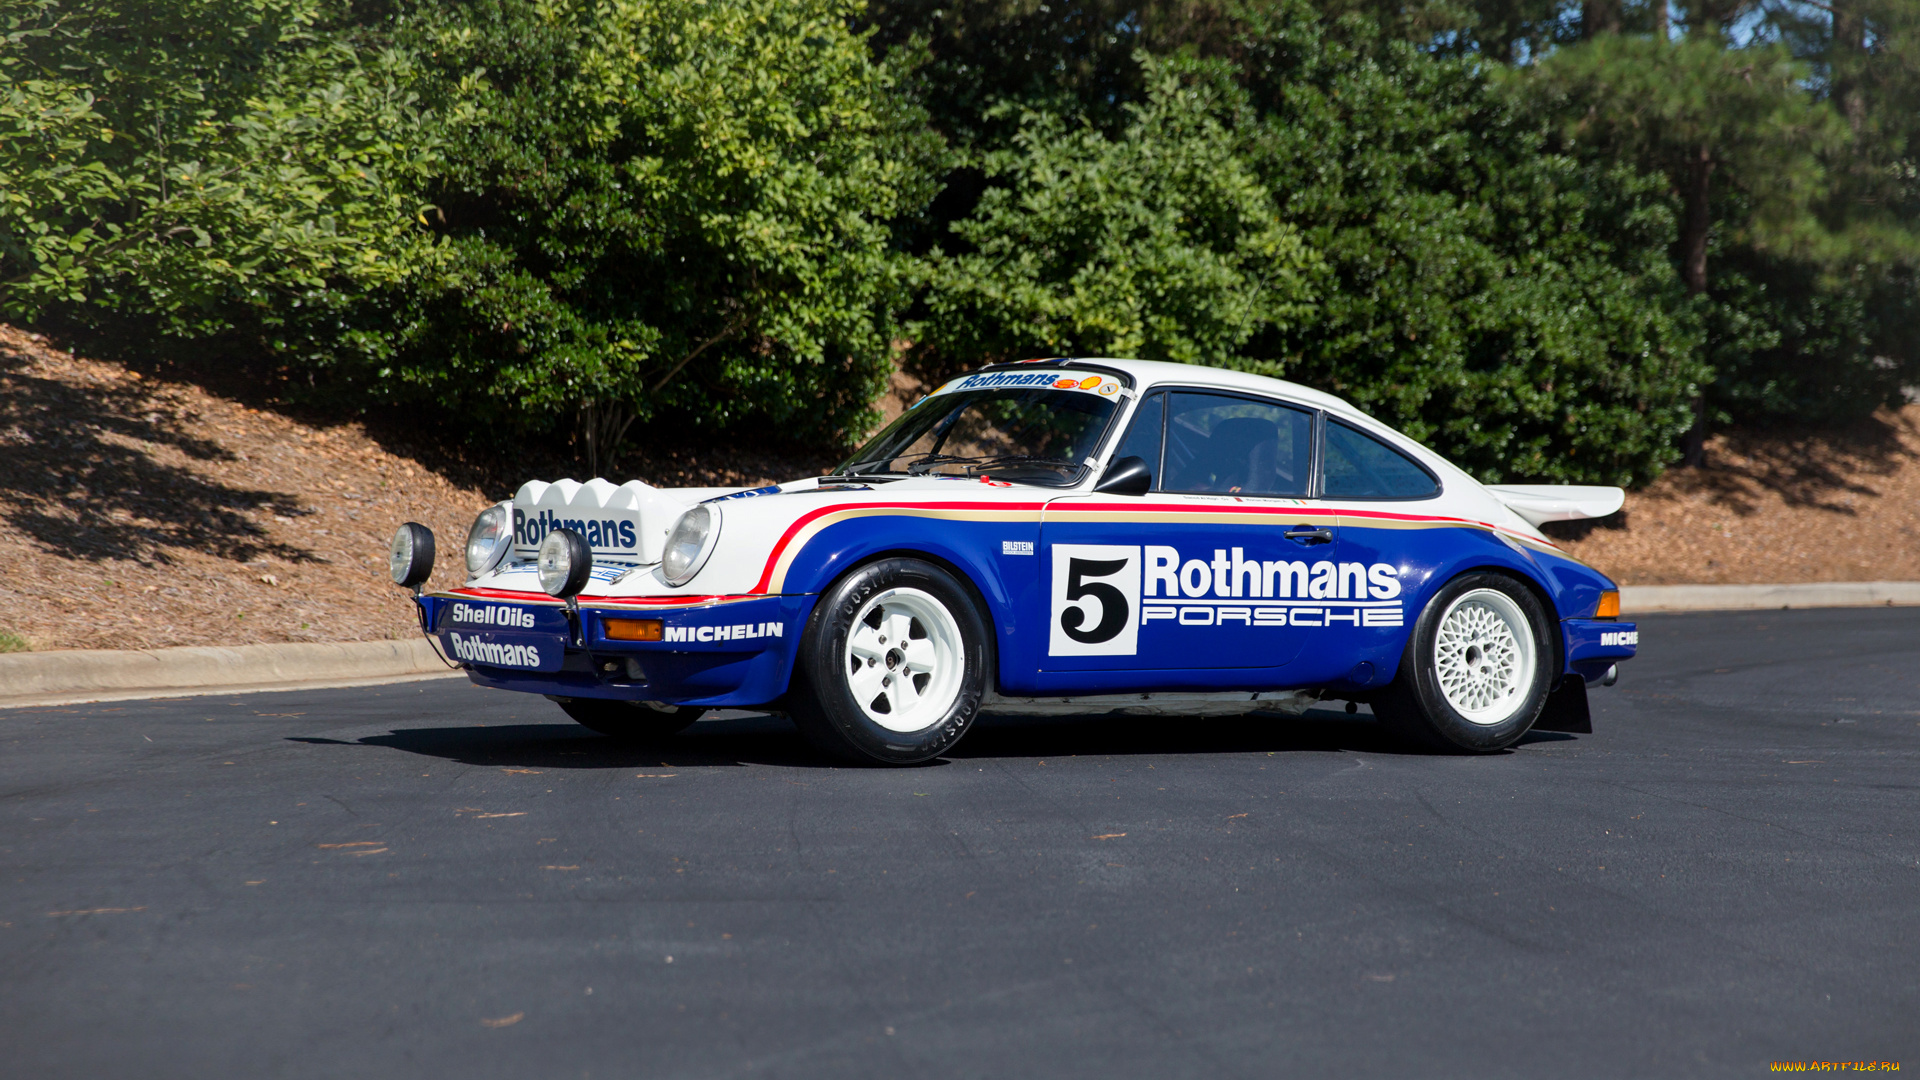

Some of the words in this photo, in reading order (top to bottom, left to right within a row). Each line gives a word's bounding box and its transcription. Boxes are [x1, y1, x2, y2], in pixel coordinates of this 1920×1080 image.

[956, 371, 1060, 389] Rothmans
[1002, 541, 1034, 551] BILSTEIN
[1144, 545, 1401, 599] Rothmans
[1061, 557, 1129, 644] 5
[452, 603, 495, 624] Shell
[497, 606, 535, 628] Oils
[1142, 606, 1404, 626] PORSCHE
[664, 622, 783, 642] MICHELIN
[450, 632, 541, 667] Rothmans
